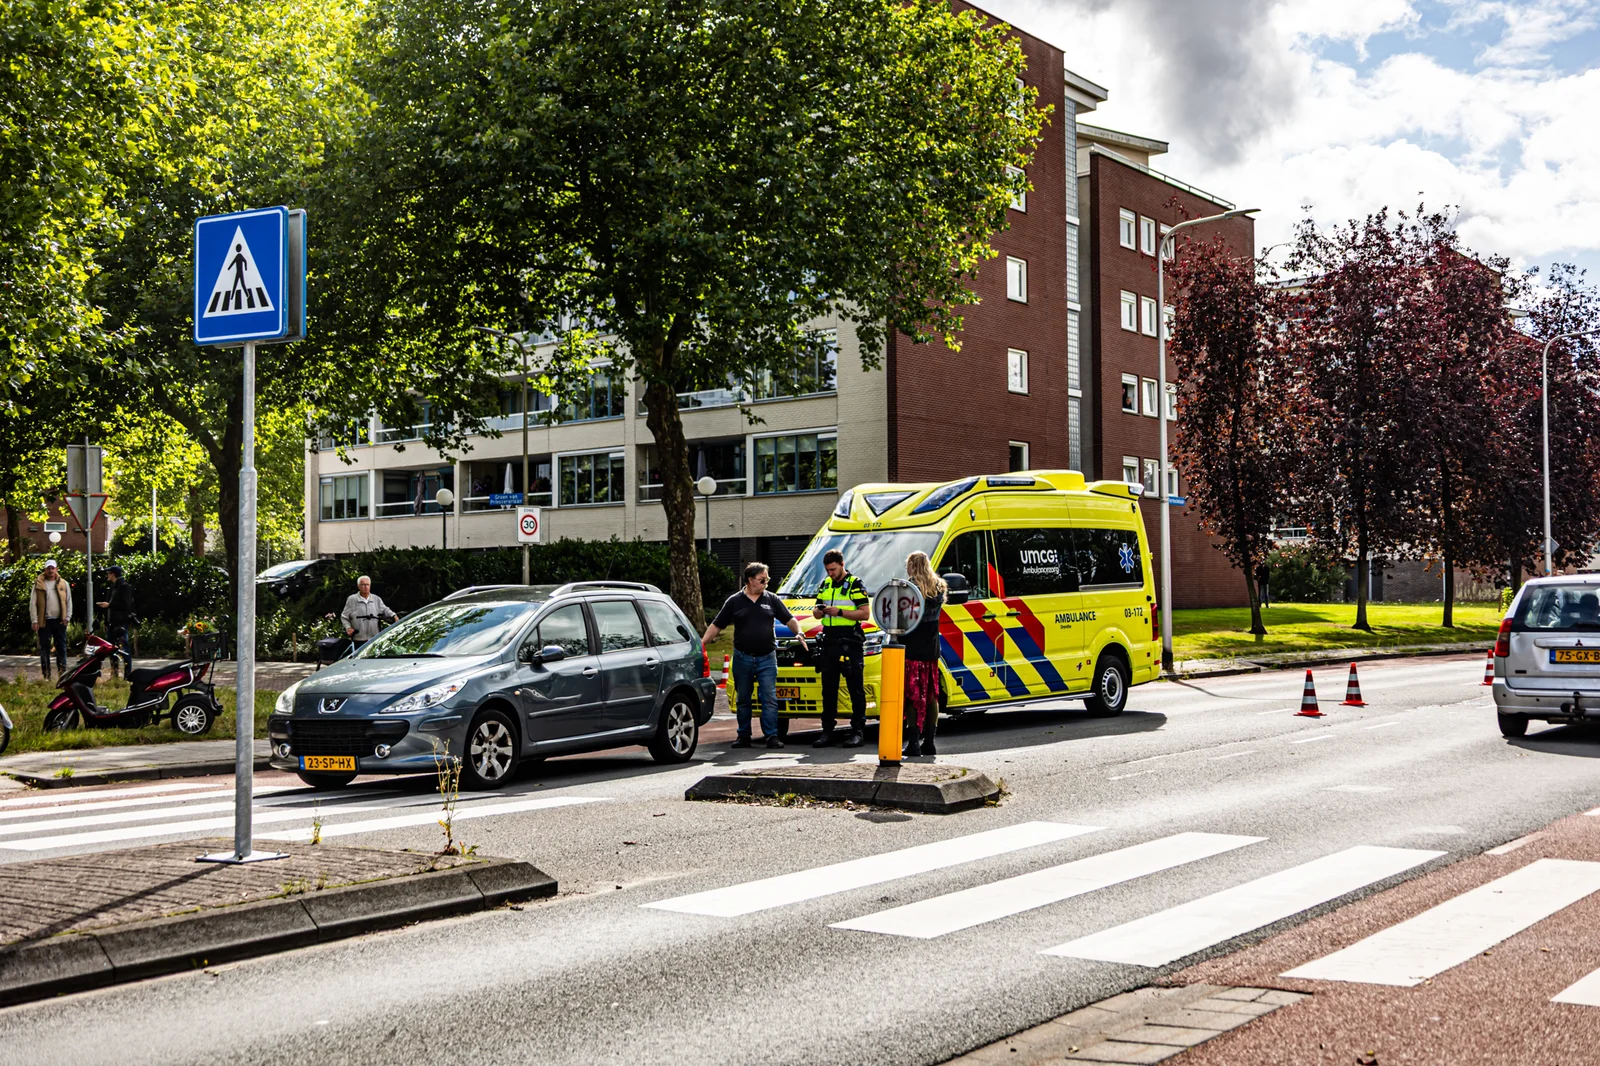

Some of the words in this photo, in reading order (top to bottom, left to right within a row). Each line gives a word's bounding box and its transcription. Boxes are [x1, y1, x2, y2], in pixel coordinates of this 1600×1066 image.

[523, 520, 535, 529] 30
[1054, 611, 1096, 624] AMBULANCE
[1124, 607, 1144, 618] 03-172
[1558, 651, 1600, 661] 75-GX-B
[308, 757, 352, 769] 23-SP-HX
